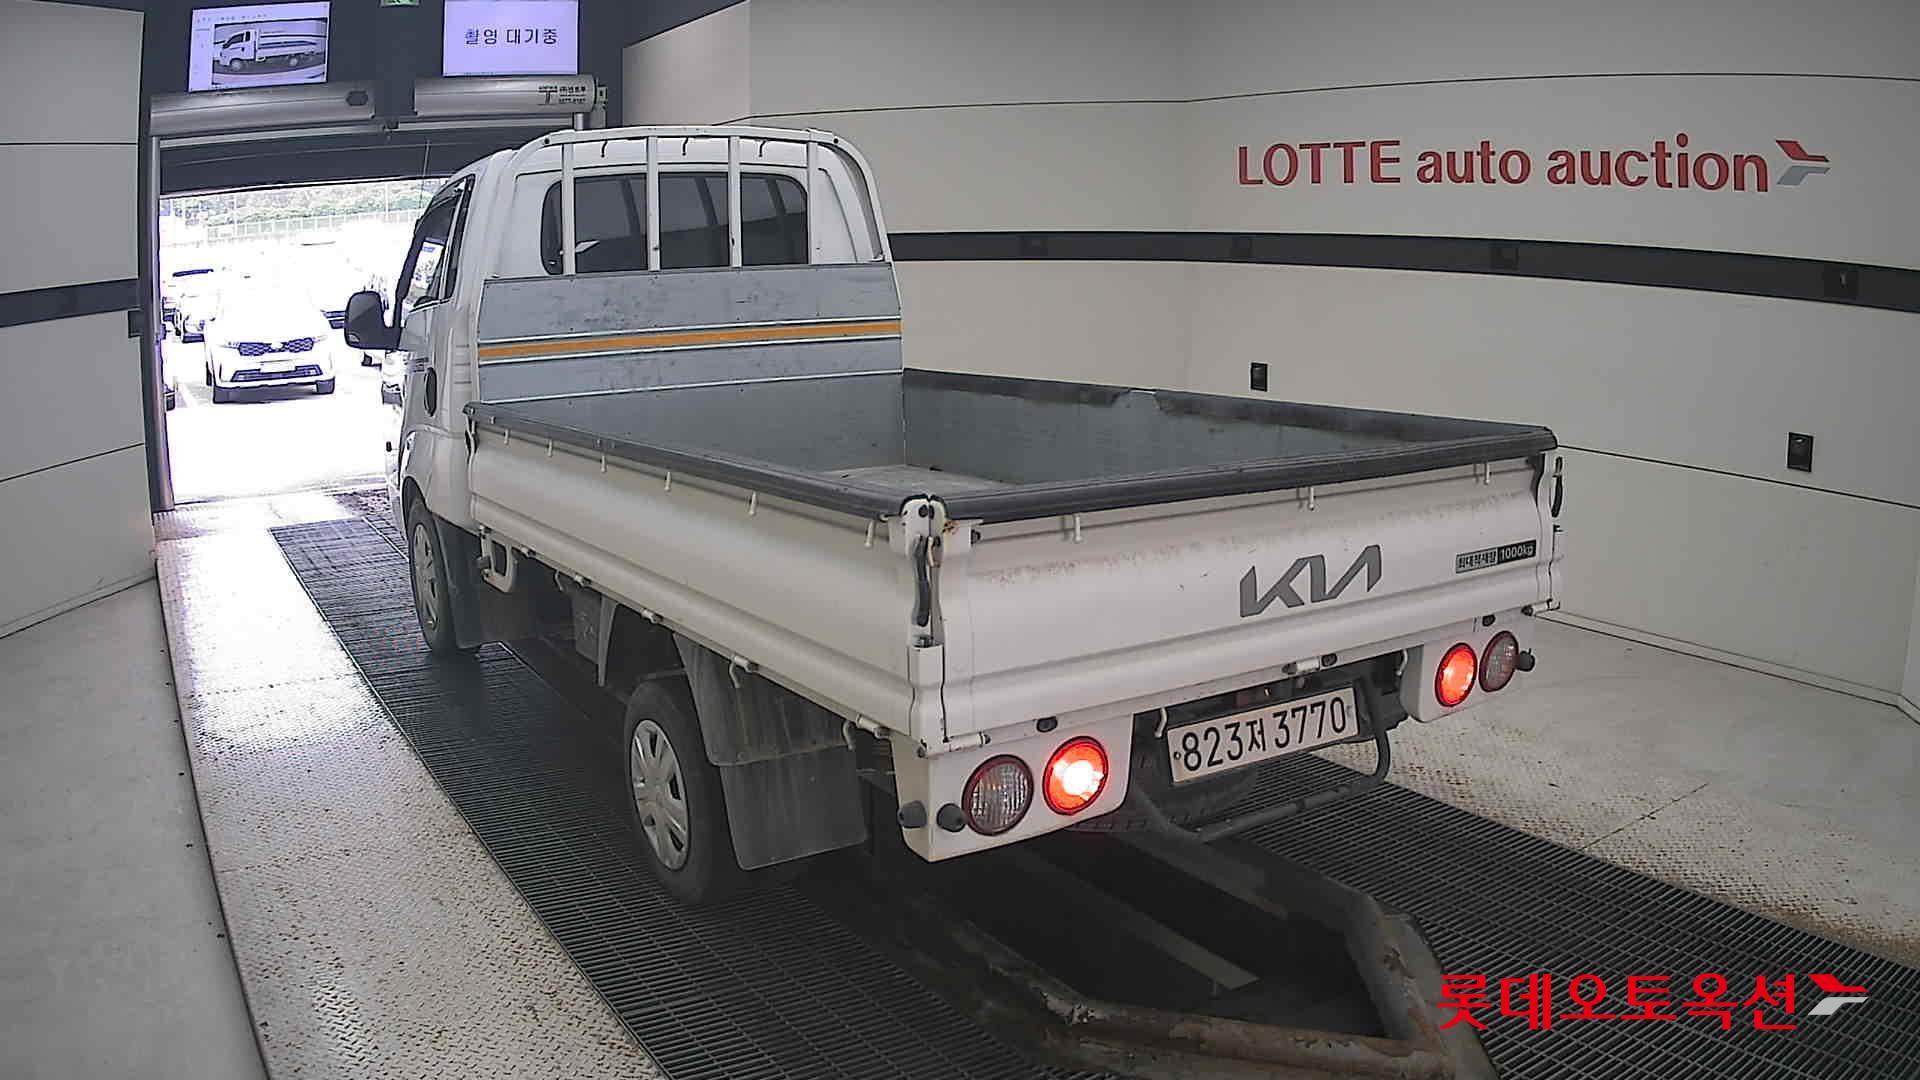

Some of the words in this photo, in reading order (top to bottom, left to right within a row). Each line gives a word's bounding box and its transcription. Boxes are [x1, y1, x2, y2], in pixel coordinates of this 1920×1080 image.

[506, 28, 557, 45] 대기중
[1239, 139, 1400, 186] LOTTE
[1416, 140, 1532, 185] auto
[1547, 133, 1769, 192] auction
[1240, 544, 1382, 617] KIA
